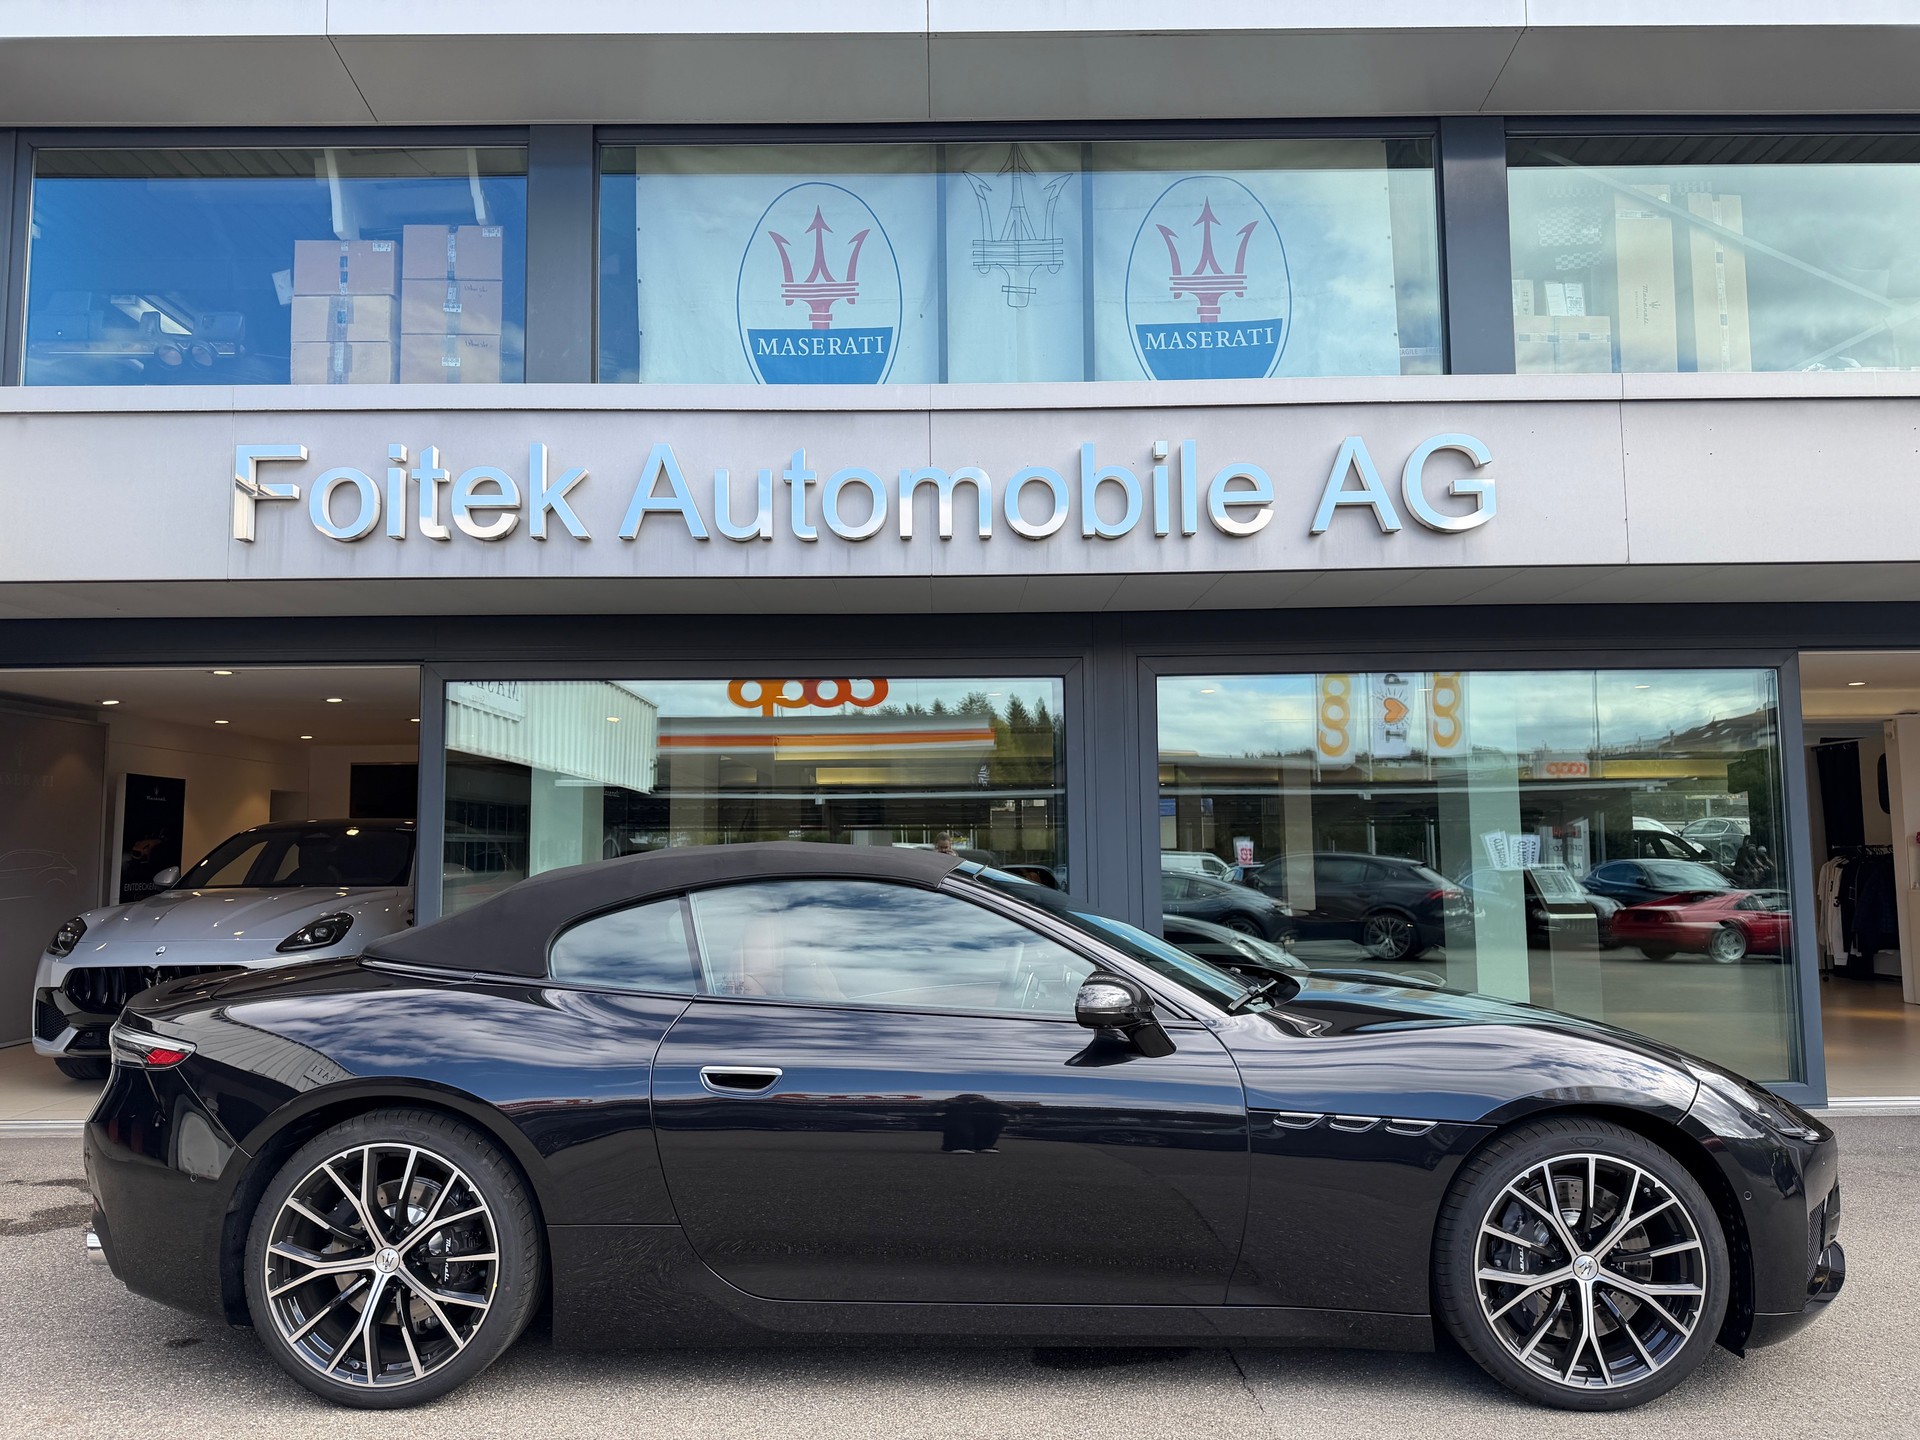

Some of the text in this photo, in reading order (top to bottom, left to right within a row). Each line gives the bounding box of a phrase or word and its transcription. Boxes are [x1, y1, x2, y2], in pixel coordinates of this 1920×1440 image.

[756, 333, 886, 358] MASERATI
[1145, 326, 1275, 351] MASERATI
[233, 433, 1498, 543] Foitek Automobile AG
